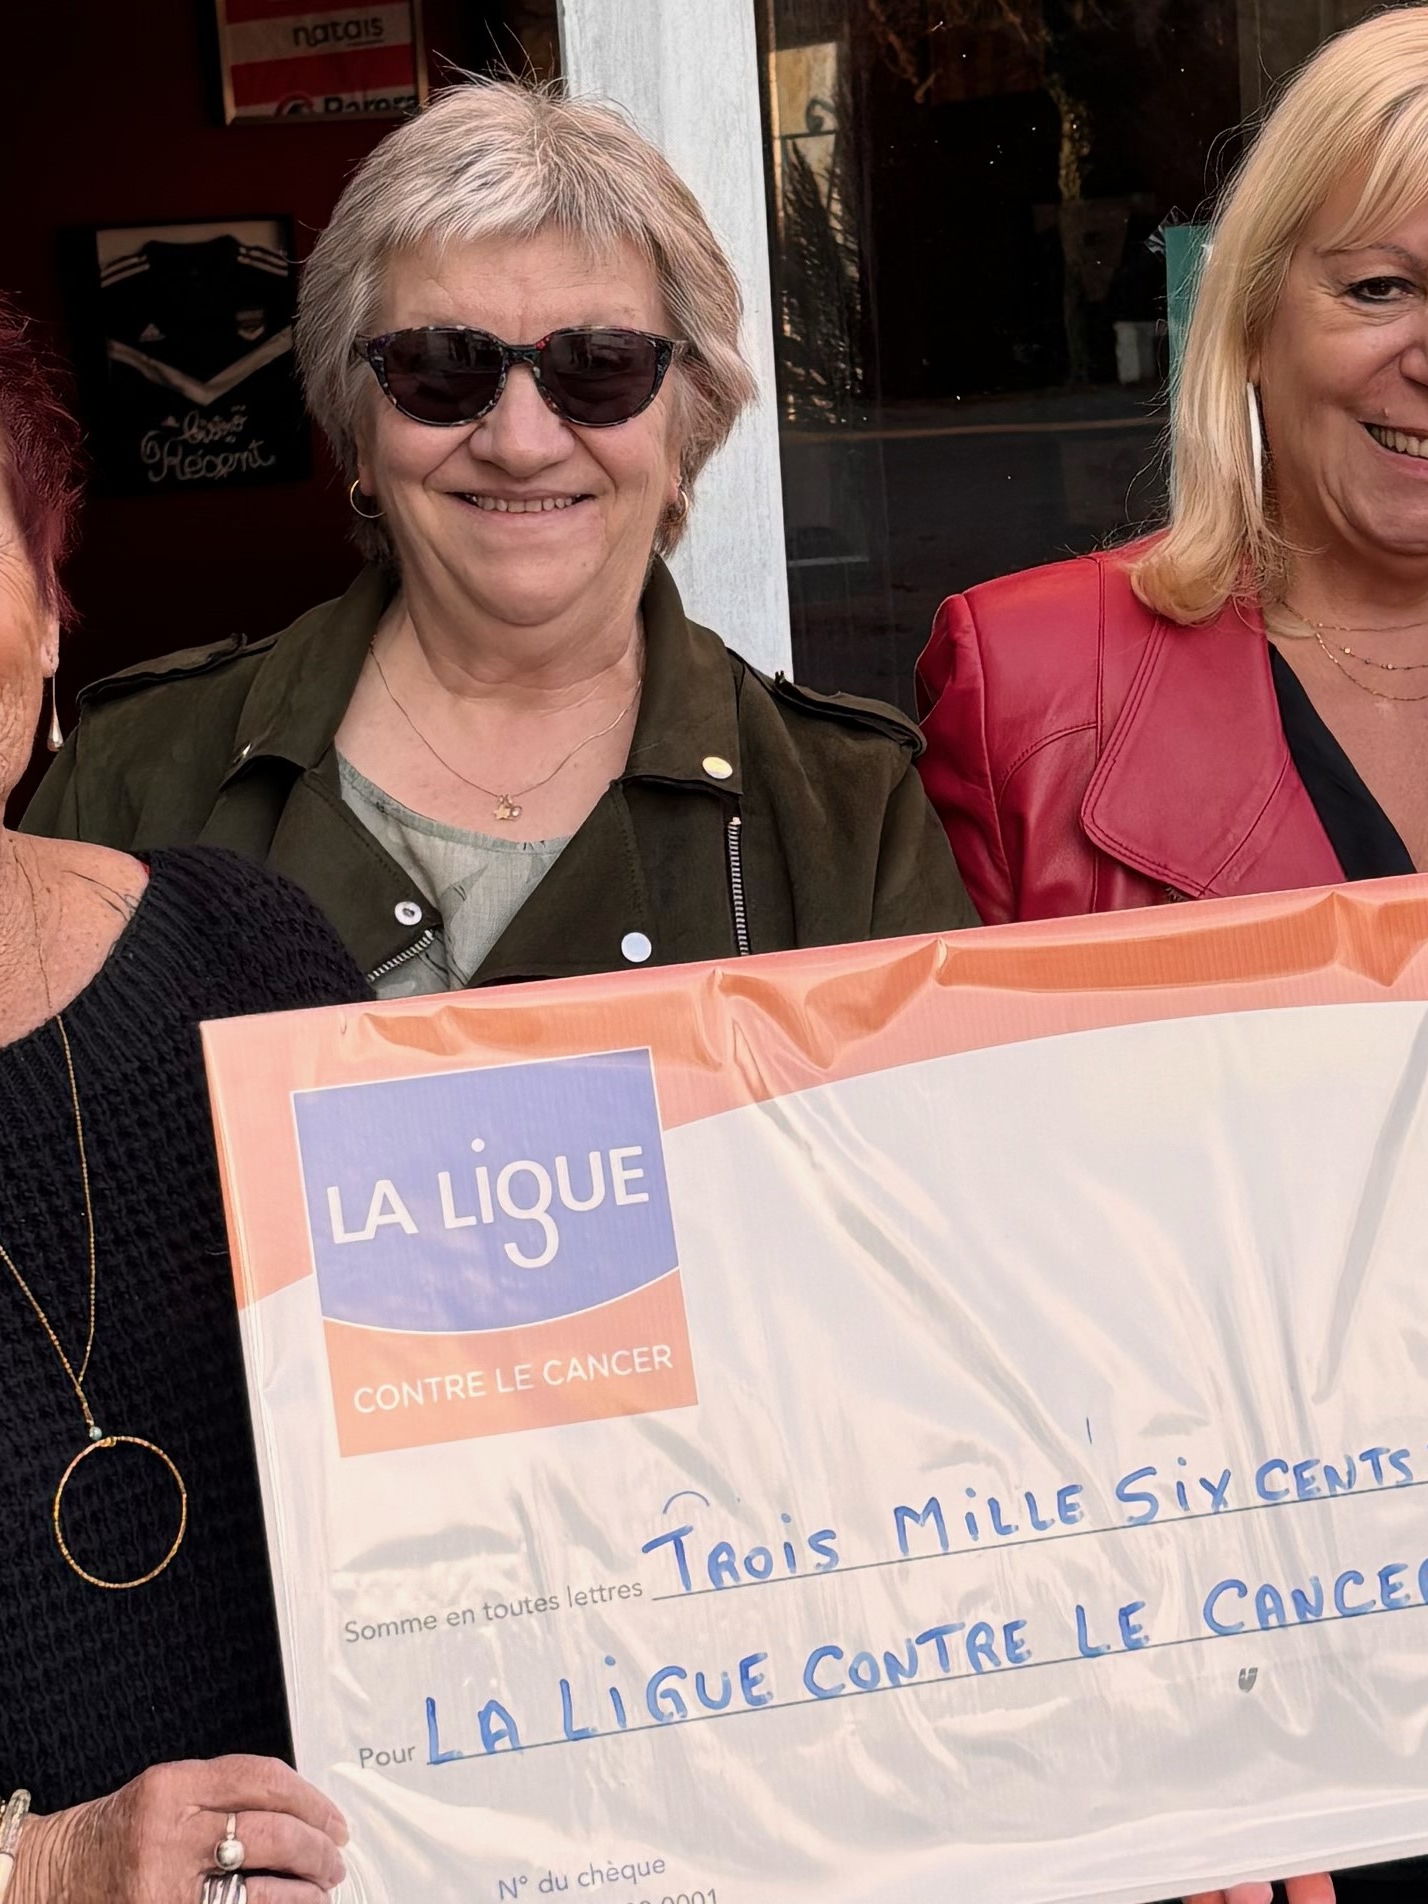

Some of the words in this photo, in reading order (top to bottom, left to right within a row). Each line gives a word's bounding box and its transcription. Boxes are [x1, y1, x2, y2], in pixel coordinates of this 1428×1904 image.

[326, 1179, 419, 1244] LA
[353, 1371, 485, 1414] CONTRE
[494, 1363, 535, 1394] LE
[542, 1344, 673, 1387] CANCER
[344, 1611, 439, 1643] Somme
[446, 1606, 476, 1628] en
[483, 1591, 560, 1623] toutes
[566, 1580, 644, 1611] lettres
[425, 1696, 521, 1765] LA
[802, 1619, 1032, 1700] CONTRE
[1074, 1599, 1149, 1659] LE
[358, 1742, 416, 1770] Pour
[499, 1875, 528, 1901] N°
[538, 1871, 569, 1894] du
[577, 1856, 666, 1890] chèque
